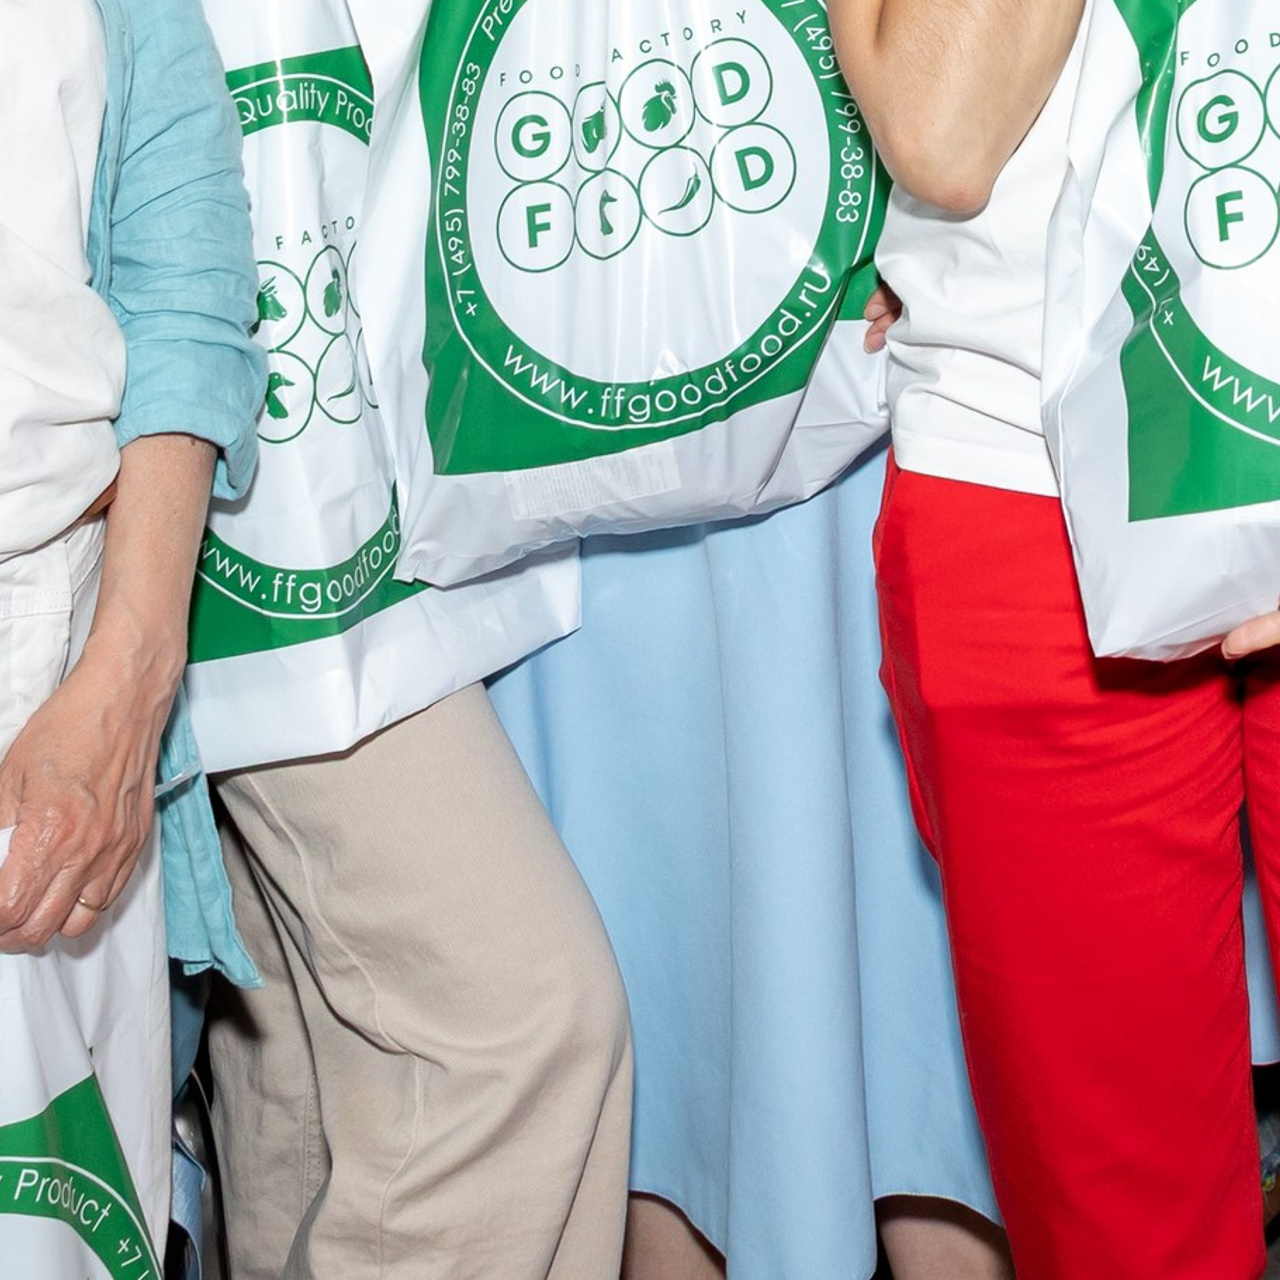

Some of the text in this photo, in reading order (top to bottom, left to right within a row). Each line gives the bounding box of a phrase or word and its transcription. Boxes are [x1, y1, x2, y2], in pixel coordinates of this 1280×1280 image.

[611, 10, 747, 62] ACTORY
[234, 82, 330, 125] Quality
[444, 62, 481, 317] +7 (495) 799-38-83
[275, 216, 355, 250] FACTO
[503, 263, 832, 422] www.ffgoodfood.ru
[14, 1168, 143, 1267] Product +7
